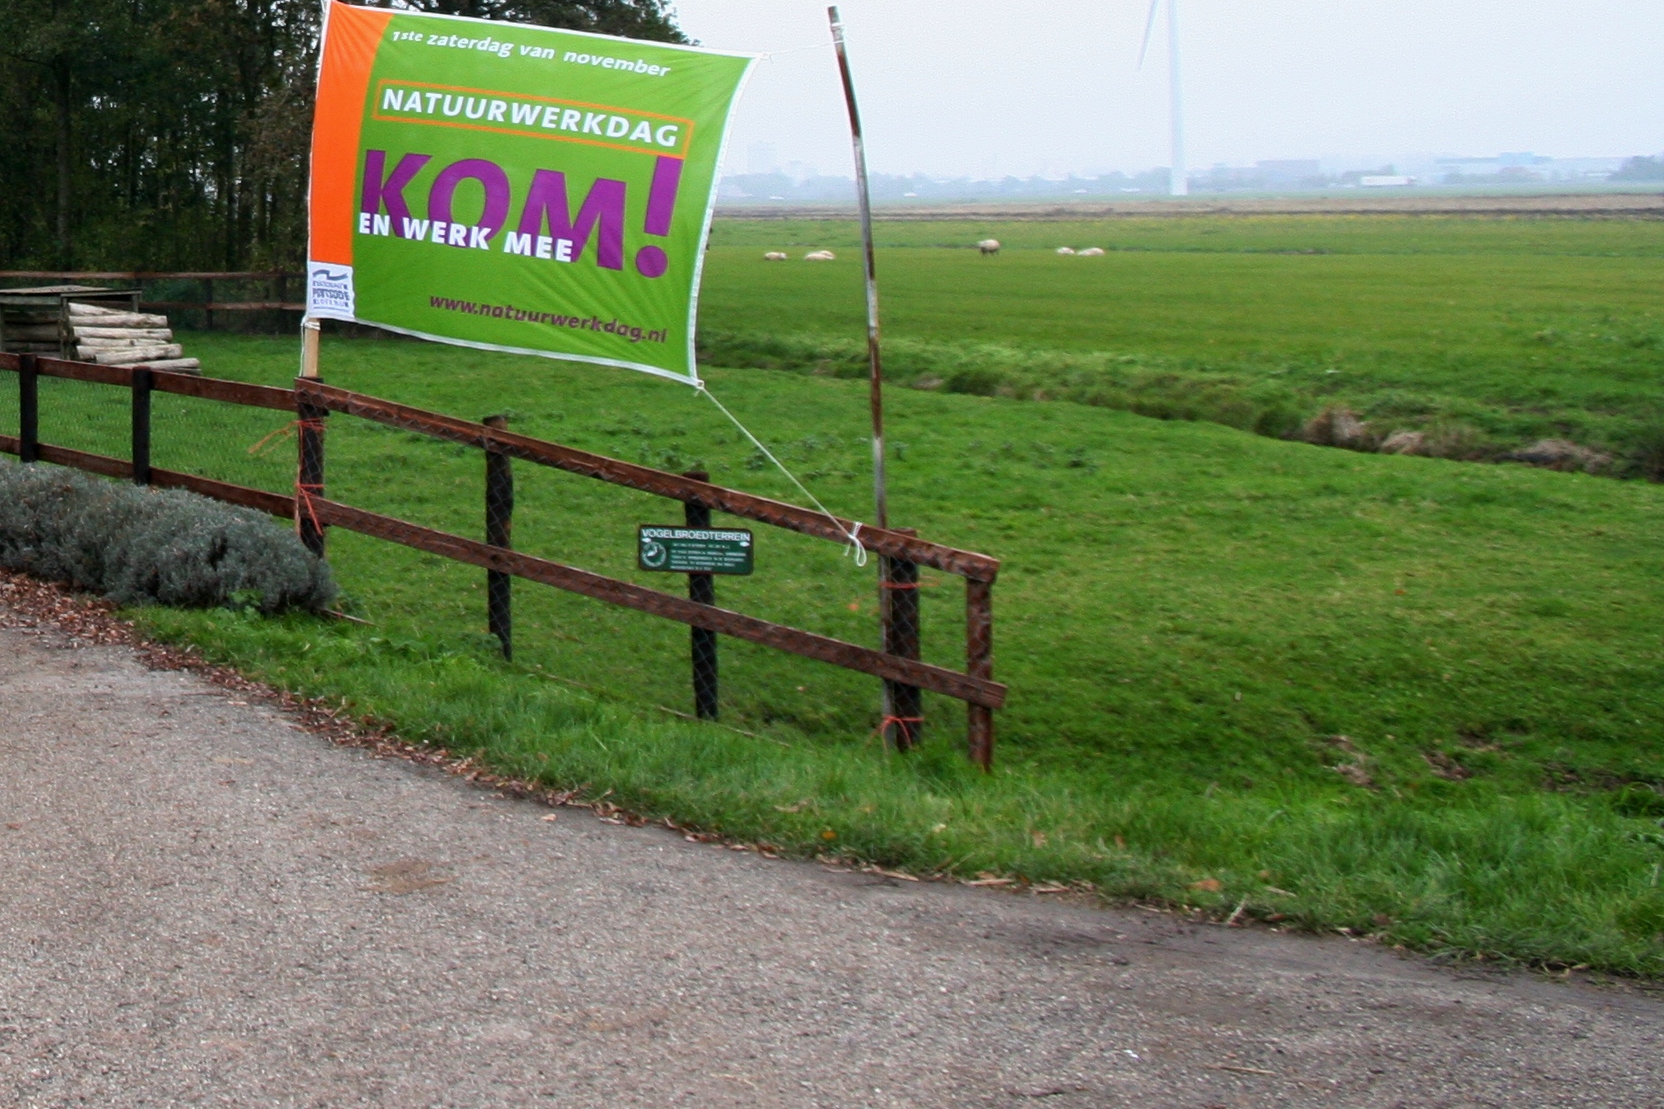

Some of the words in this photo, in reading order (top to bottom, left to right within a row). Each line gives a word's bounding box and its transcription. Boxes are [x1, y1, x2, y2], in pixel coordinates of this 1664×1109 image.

[393, 30, 423, 44] 1ste
[427, 32, 514, 59] zaterdag
[520, 42, 555, 60] van
[564, 49, 671, 78] november
[382, 88, 679, 148] NATUURWERKDAG
[359, 212, 390, 237] EN
[402, 217, 492, 251] WERK
[503, 231, 574, 263] MEE
[360, 149, 684, 278] KOM!
[429, 294, 668, 344] www.natuurwerkdag.nl
[641, 528, 751, 542] VOGELBROEDTERREIN
